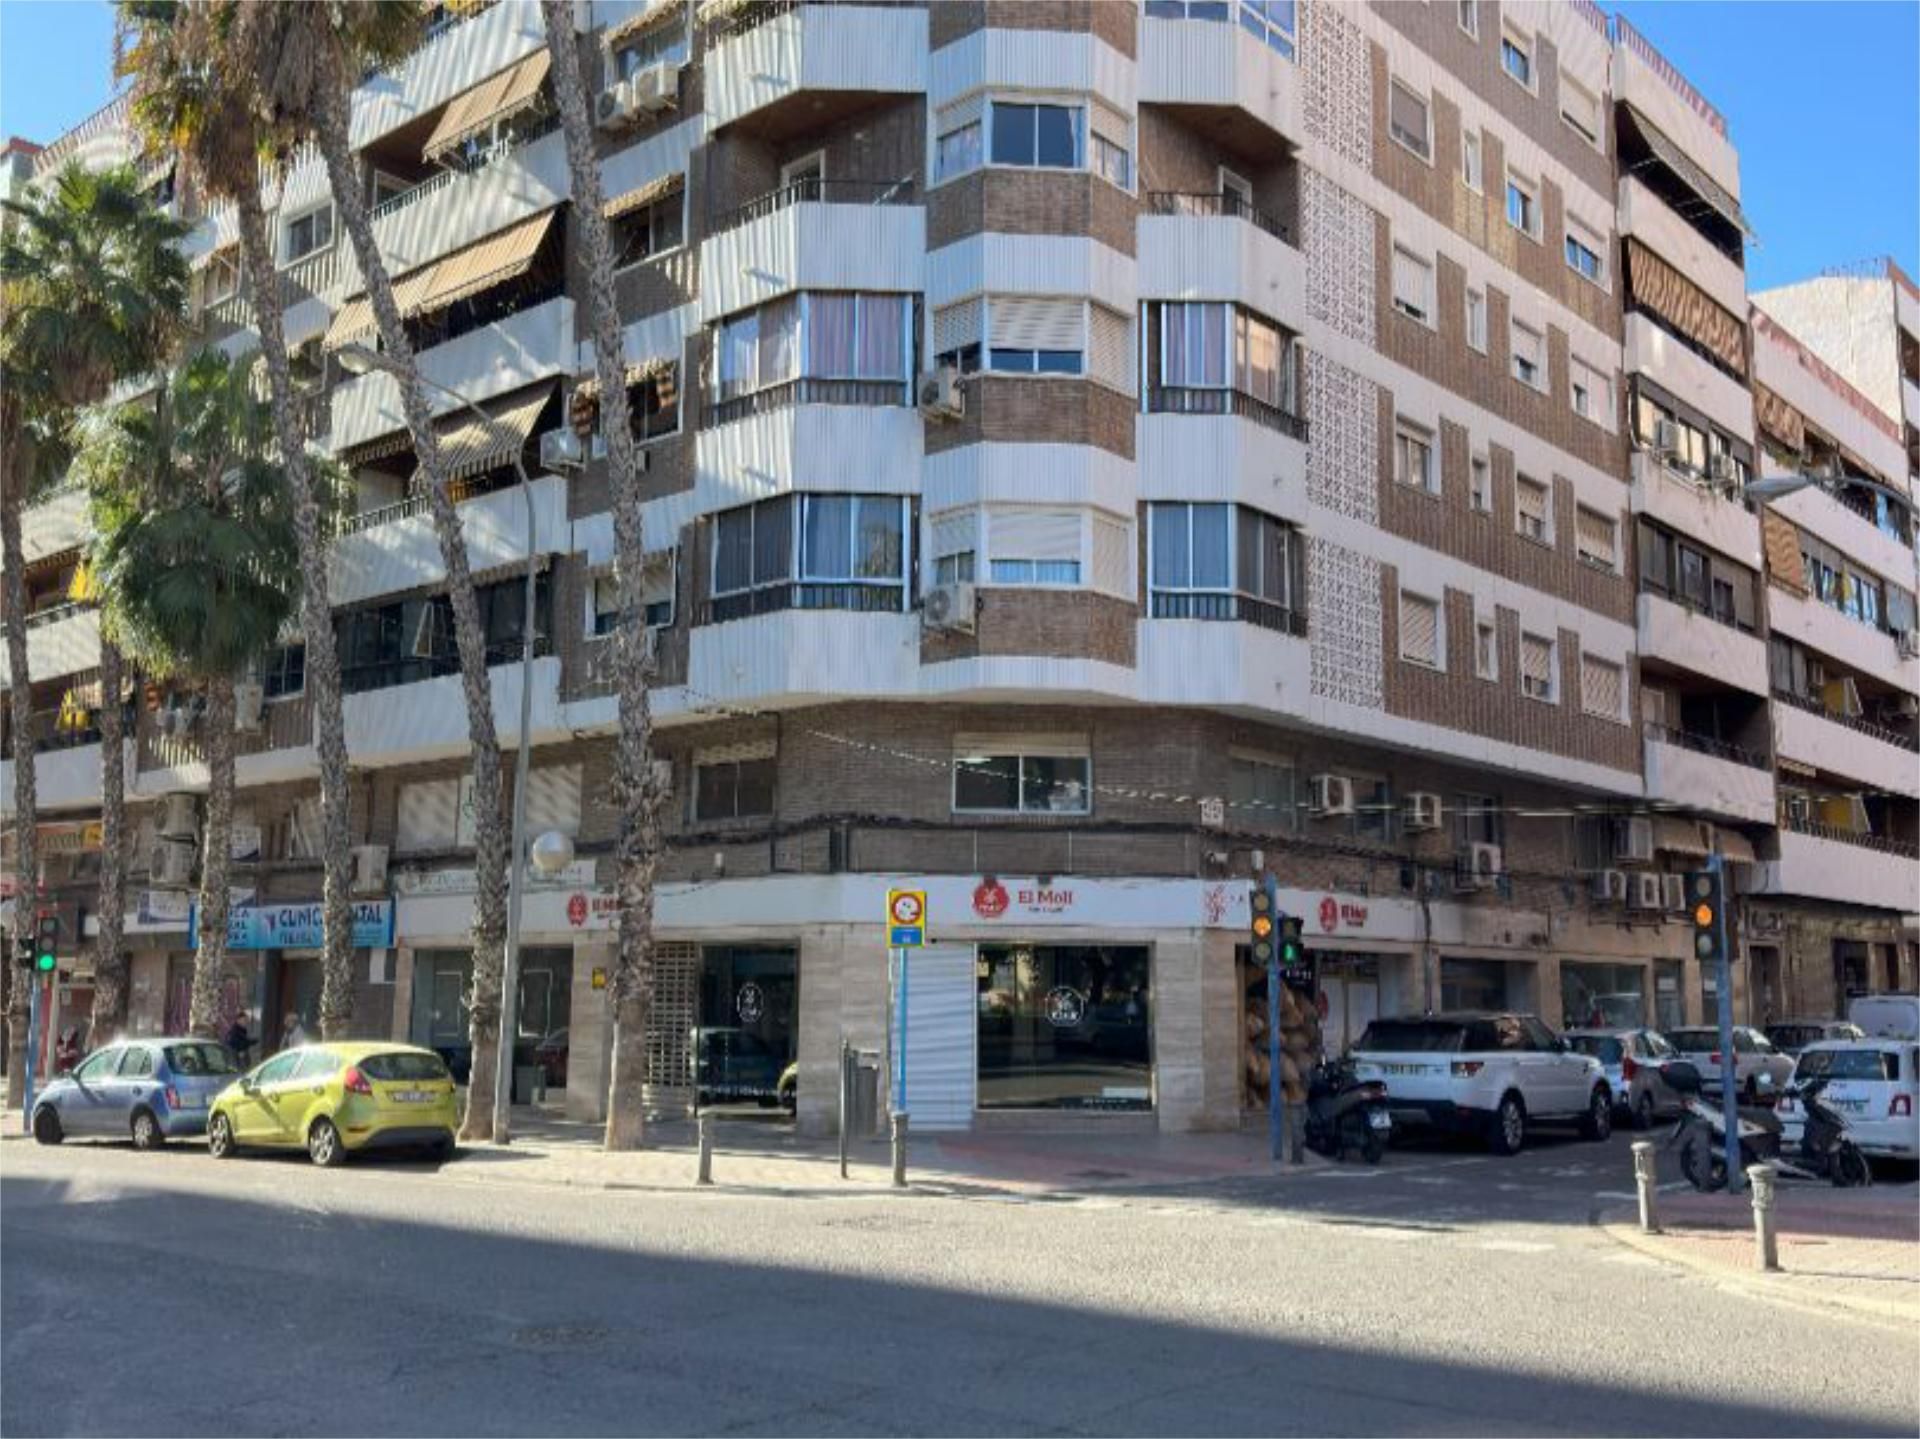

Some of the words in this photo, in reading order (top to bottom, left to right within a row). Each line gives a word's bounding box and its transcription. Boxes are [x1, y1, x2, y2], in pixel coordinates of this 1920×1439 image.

[1018, 890, 1033, 904] El
[1038, 889, 1072, 905] Moll
[279, 906, 323, 927] CLINIC
